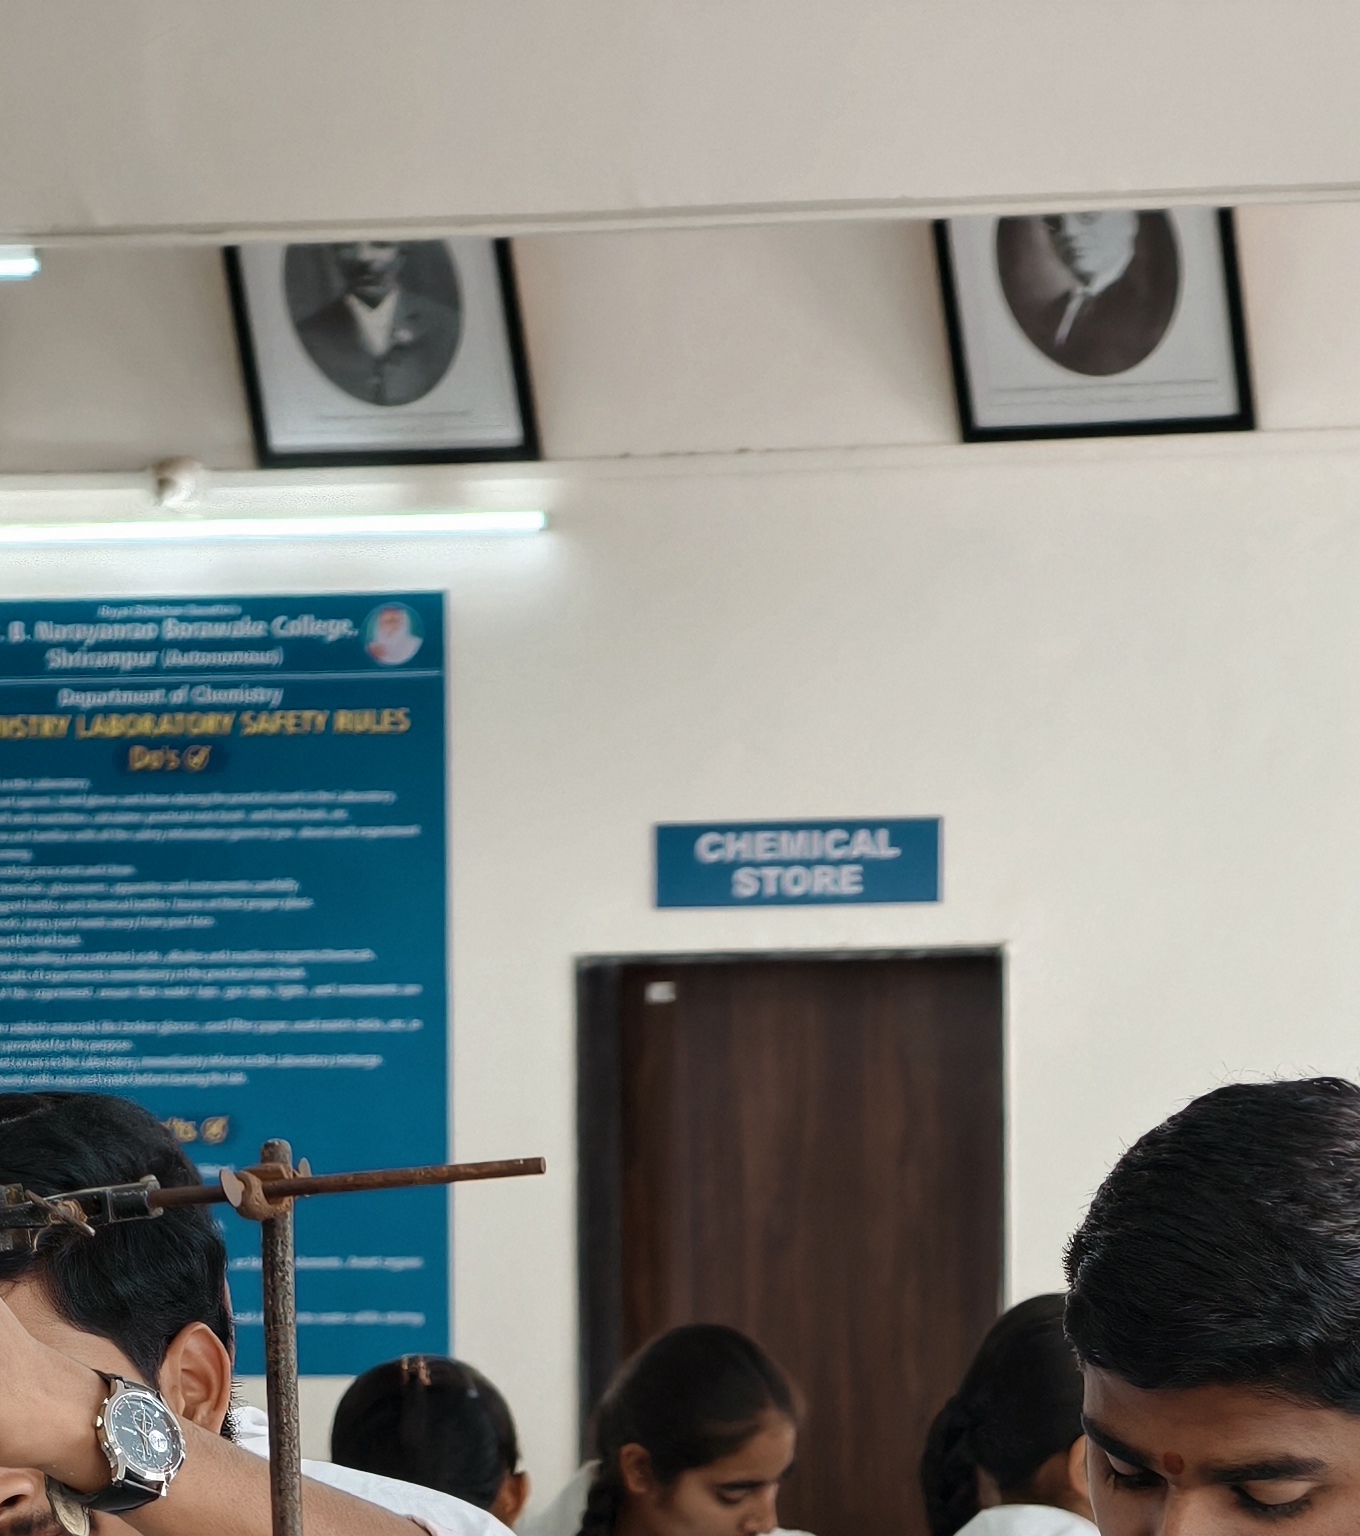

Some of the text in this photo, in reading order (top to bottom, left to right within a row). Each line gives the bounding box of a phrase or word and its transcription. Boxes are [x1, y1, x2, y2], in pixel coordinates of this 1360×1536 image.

[57, 684, 284, 712] Department of Chemistry
[74, 710, 237, 739] LABORATORY
[240, 709, 330, 736] SAFETY
[332, 706, 412, 734] RULES
[694, 828, 902, 863] CHEMICAL
[731, 864, 863, 897] STORE
